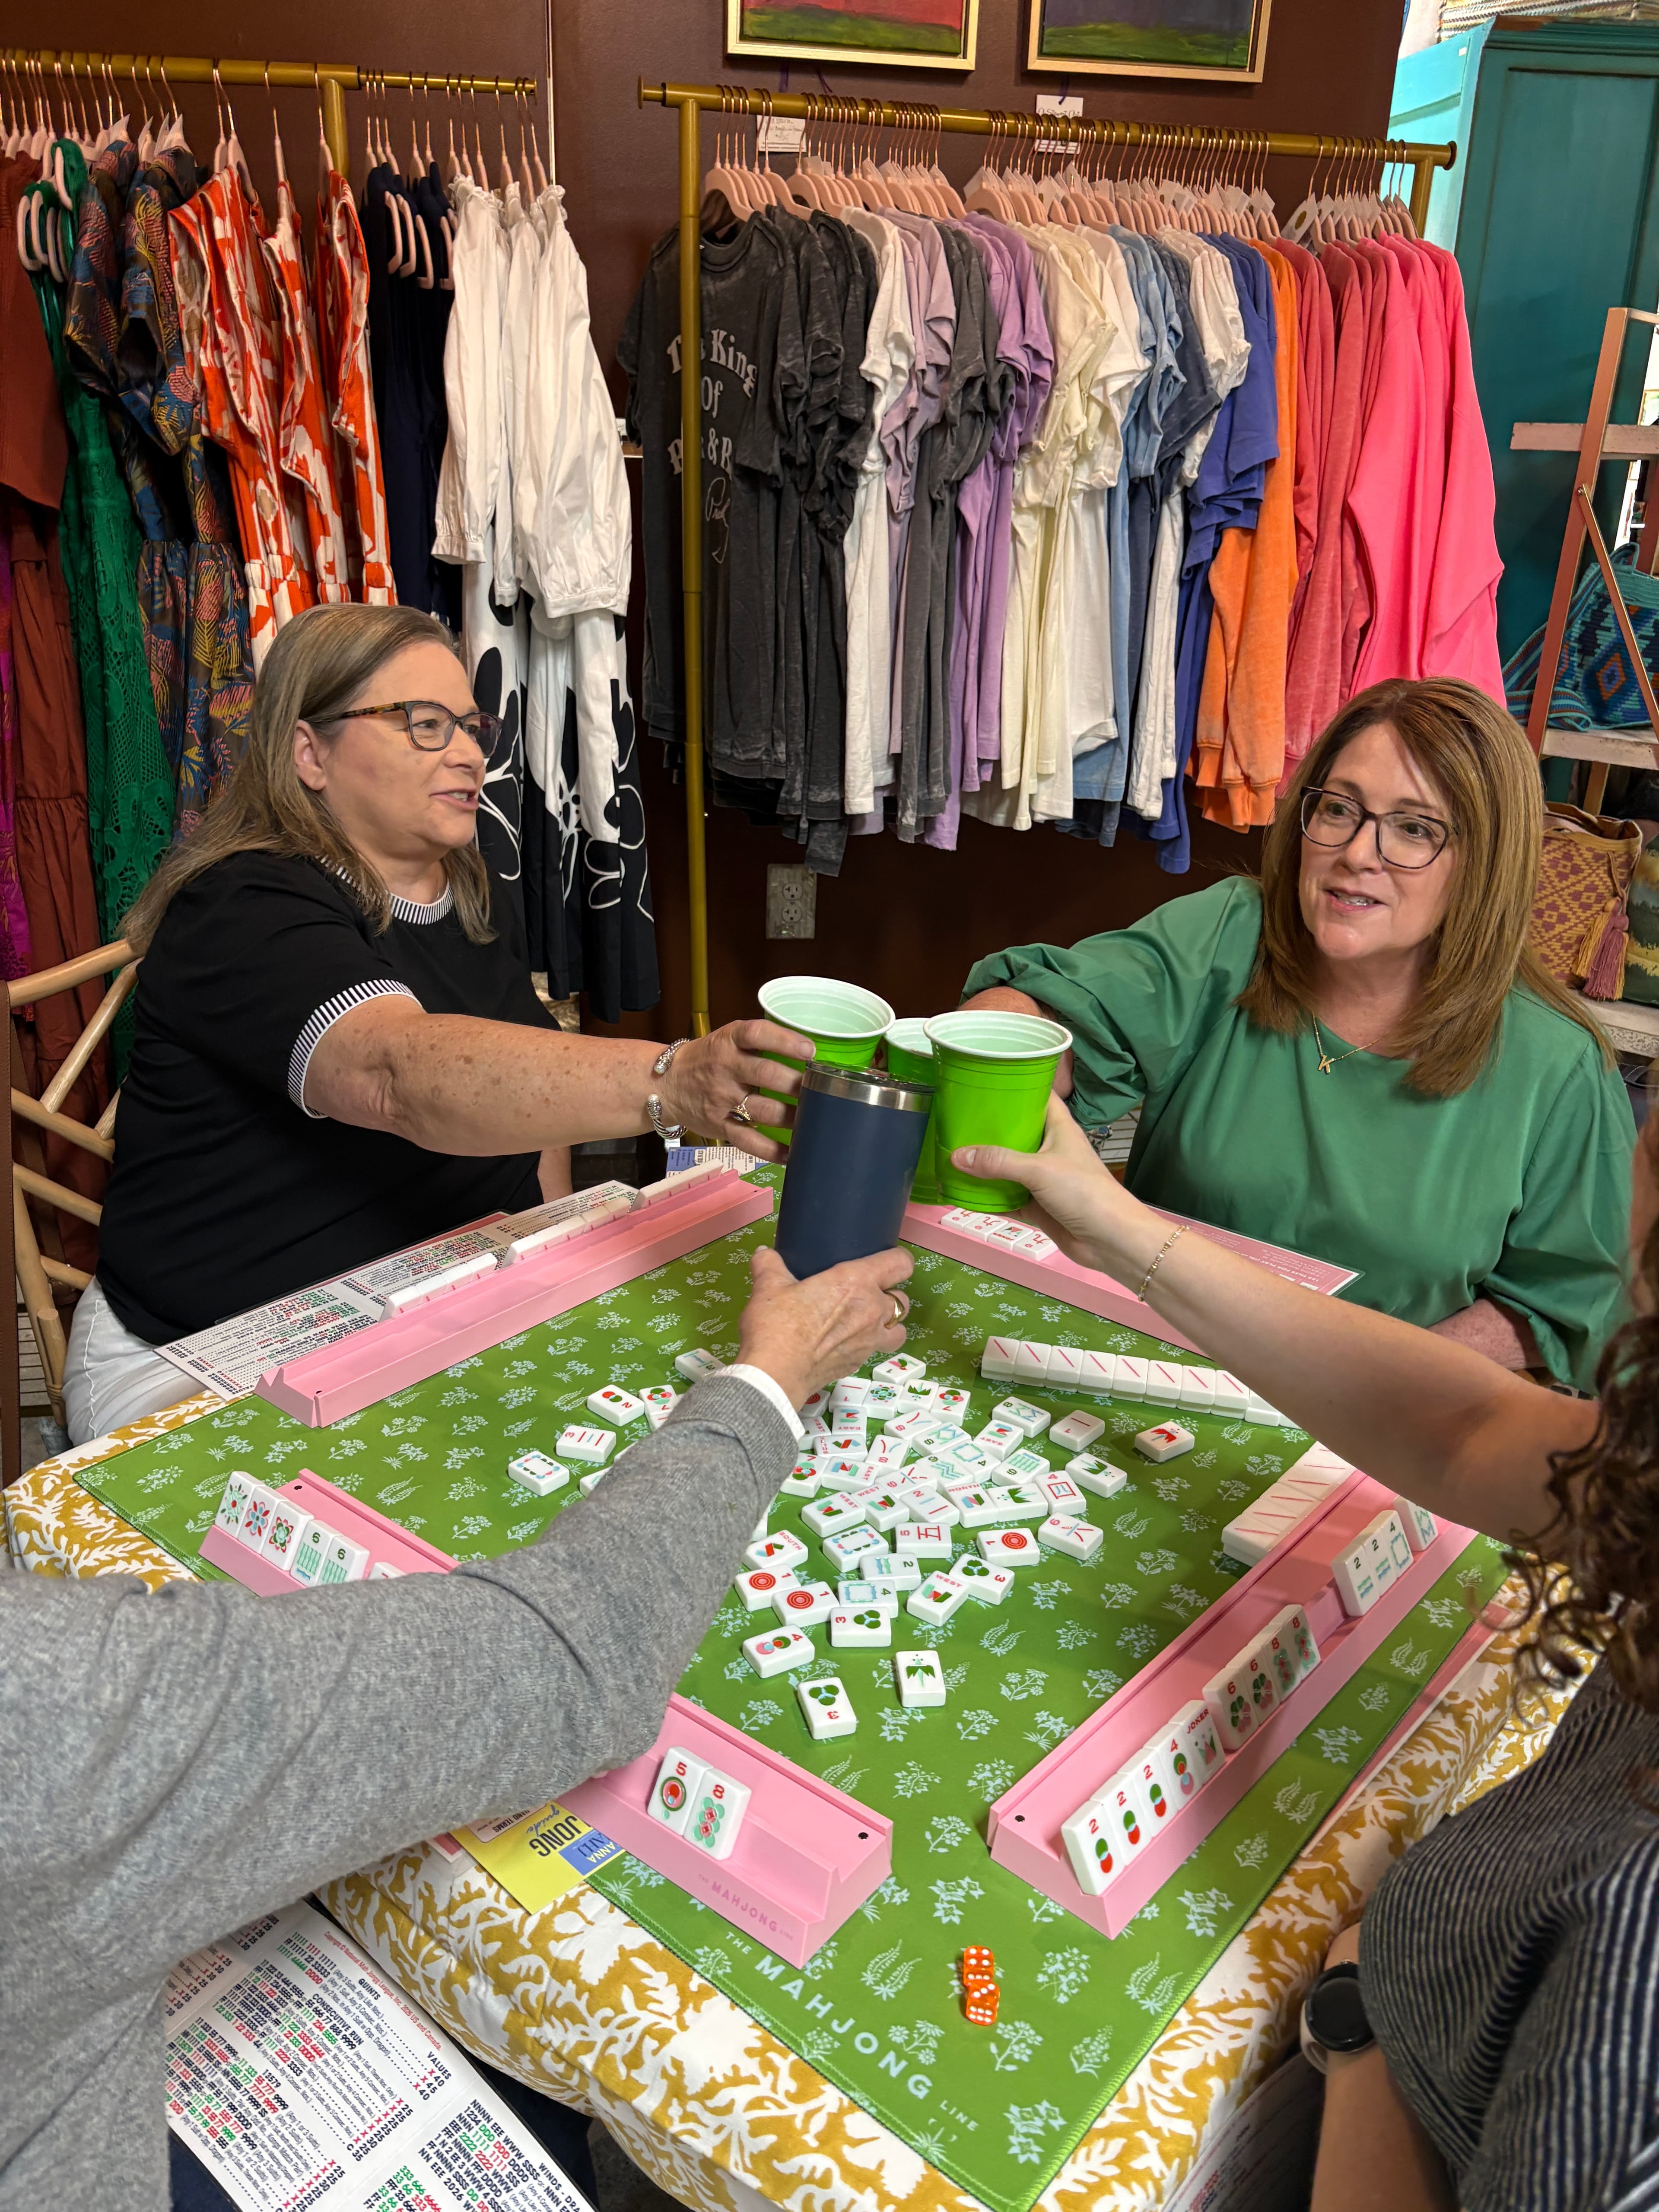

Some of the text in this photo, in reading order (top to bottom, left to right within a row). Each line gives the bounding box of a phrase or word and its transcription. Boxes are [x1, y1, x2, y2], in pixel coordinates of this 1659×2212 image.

[980, 1437, 1004, 1446] EAST
[857, 1486, 880, 1497] WEST
[948, 1484, 980, 1492] NORTH
[839, 1494, 859, 1509] WEST
[312, 1532, 321, 1544] 6
[779, 1531, 803, 1551] SOUTH
[1371, 1539, 1379, 1552] 2
[337, 1548, 346, 1560] 6
[1353, 1557, 1362, 1570] 2
[935, 1573, 963, 1588] WEST
[994, 1574, 1006, 1583] 3
[881, 1587, 892, 1595] 4
[1292, 1617, 1300, 1629] 8
[791, 1633, 803, 1642] 4
[1271, 1637, 1280, 1650] 8
[1250, 1659, 1258, 1672] 6
[1227, 1681, 1236, 1695] 6
[827, 1710, 840, 1720] 3
[1187, 1708, 1209, 1734] JOKER
[1170, 1738, 1179, 1753] 4
[675, 1761, 687, 1777] 5
[1143, 1764, 1154, 1780] 2
[712, 1783, 725, 1799] 8
[1117, 1791, 1127, 1807] 2
[526, 1804, 560, 1837] guide
[1089, 1818, 1099, 1834] 2
[529, 1814, 583, 1857] JONG
[587, 1841, 617, 1864] ANNA
[710, 1881, 779, 1933] MAHJONG
[358, 1978, 381, 2000] QUINTS
[312, 1993, 364, 2046] CONSECUTIVE RUN
[410, 2014, 420, 2024] US
[416, 2022, 427, 2033] and
[305, 1968, 430, 2101] DDDD X 40
[725, 1932, 979, 2132] THE MAHJONG LINE
[427, 2051, 451, 2080] VALUES
[262, 2069, 281, 2088] 13579
[420, 2075, 429, 2083] X
[426, 2082, 438, 2094] 45
[427, 2069, 436, 2077] X
[433, 2075, 445, 2087] 40
[388, 2104, 406, 2123] X 25
[395, 2098, 404, 2106] X
[401, 2104, 413, 2116] 25
[374, 2117, 392, 2136] X 25
[381, 2111, 399, 2129] X 25
[470, 2099, 524, 2160] NNNN EEE WWW
[360, 2129, 378, 2148] X 30
[367, 2123, 385, 2142] X 25
[353, 2136, 371, 2155] X 25
[456, 2113, 520, 2188] NNN 1111 1111 SSS
[464, 2106, 529, 2183] 1234 DDD DDD DDDD
[352, 2149, 363, 2161] 35
[441, 2126, 502, 2197] FFF NNNN FFF DDDD
[448, 2120, 513, 2193] EEE 2222 2222 WWW
[320, 2165, 338, 2185] X 25
[327, 2159, 337, 2168] X
[333, 2165, 346, 2178] 25
[418, 2148, 464, 2201] NN EEE 2026
[426, 2140, 437, 2150] FF
[433, 2149, 455, 2173] NNNN
[466, 2188, 479, 2202] DD
[439, 2139, 448, 2148] N
[445, 2146, 453, 2155] 2
[450, 2152, 461, 2164] EE
[458, 2161, 466, 2170] 3
[464, 2167, 485, 2192] WWW
[400, 2165, 426, 2195] 333 666
[539, 2163, 562, 2190] WINDS
[392, 2171, 427, 2212] 33 66 333
[394, 2190, 406, 2202] 33
